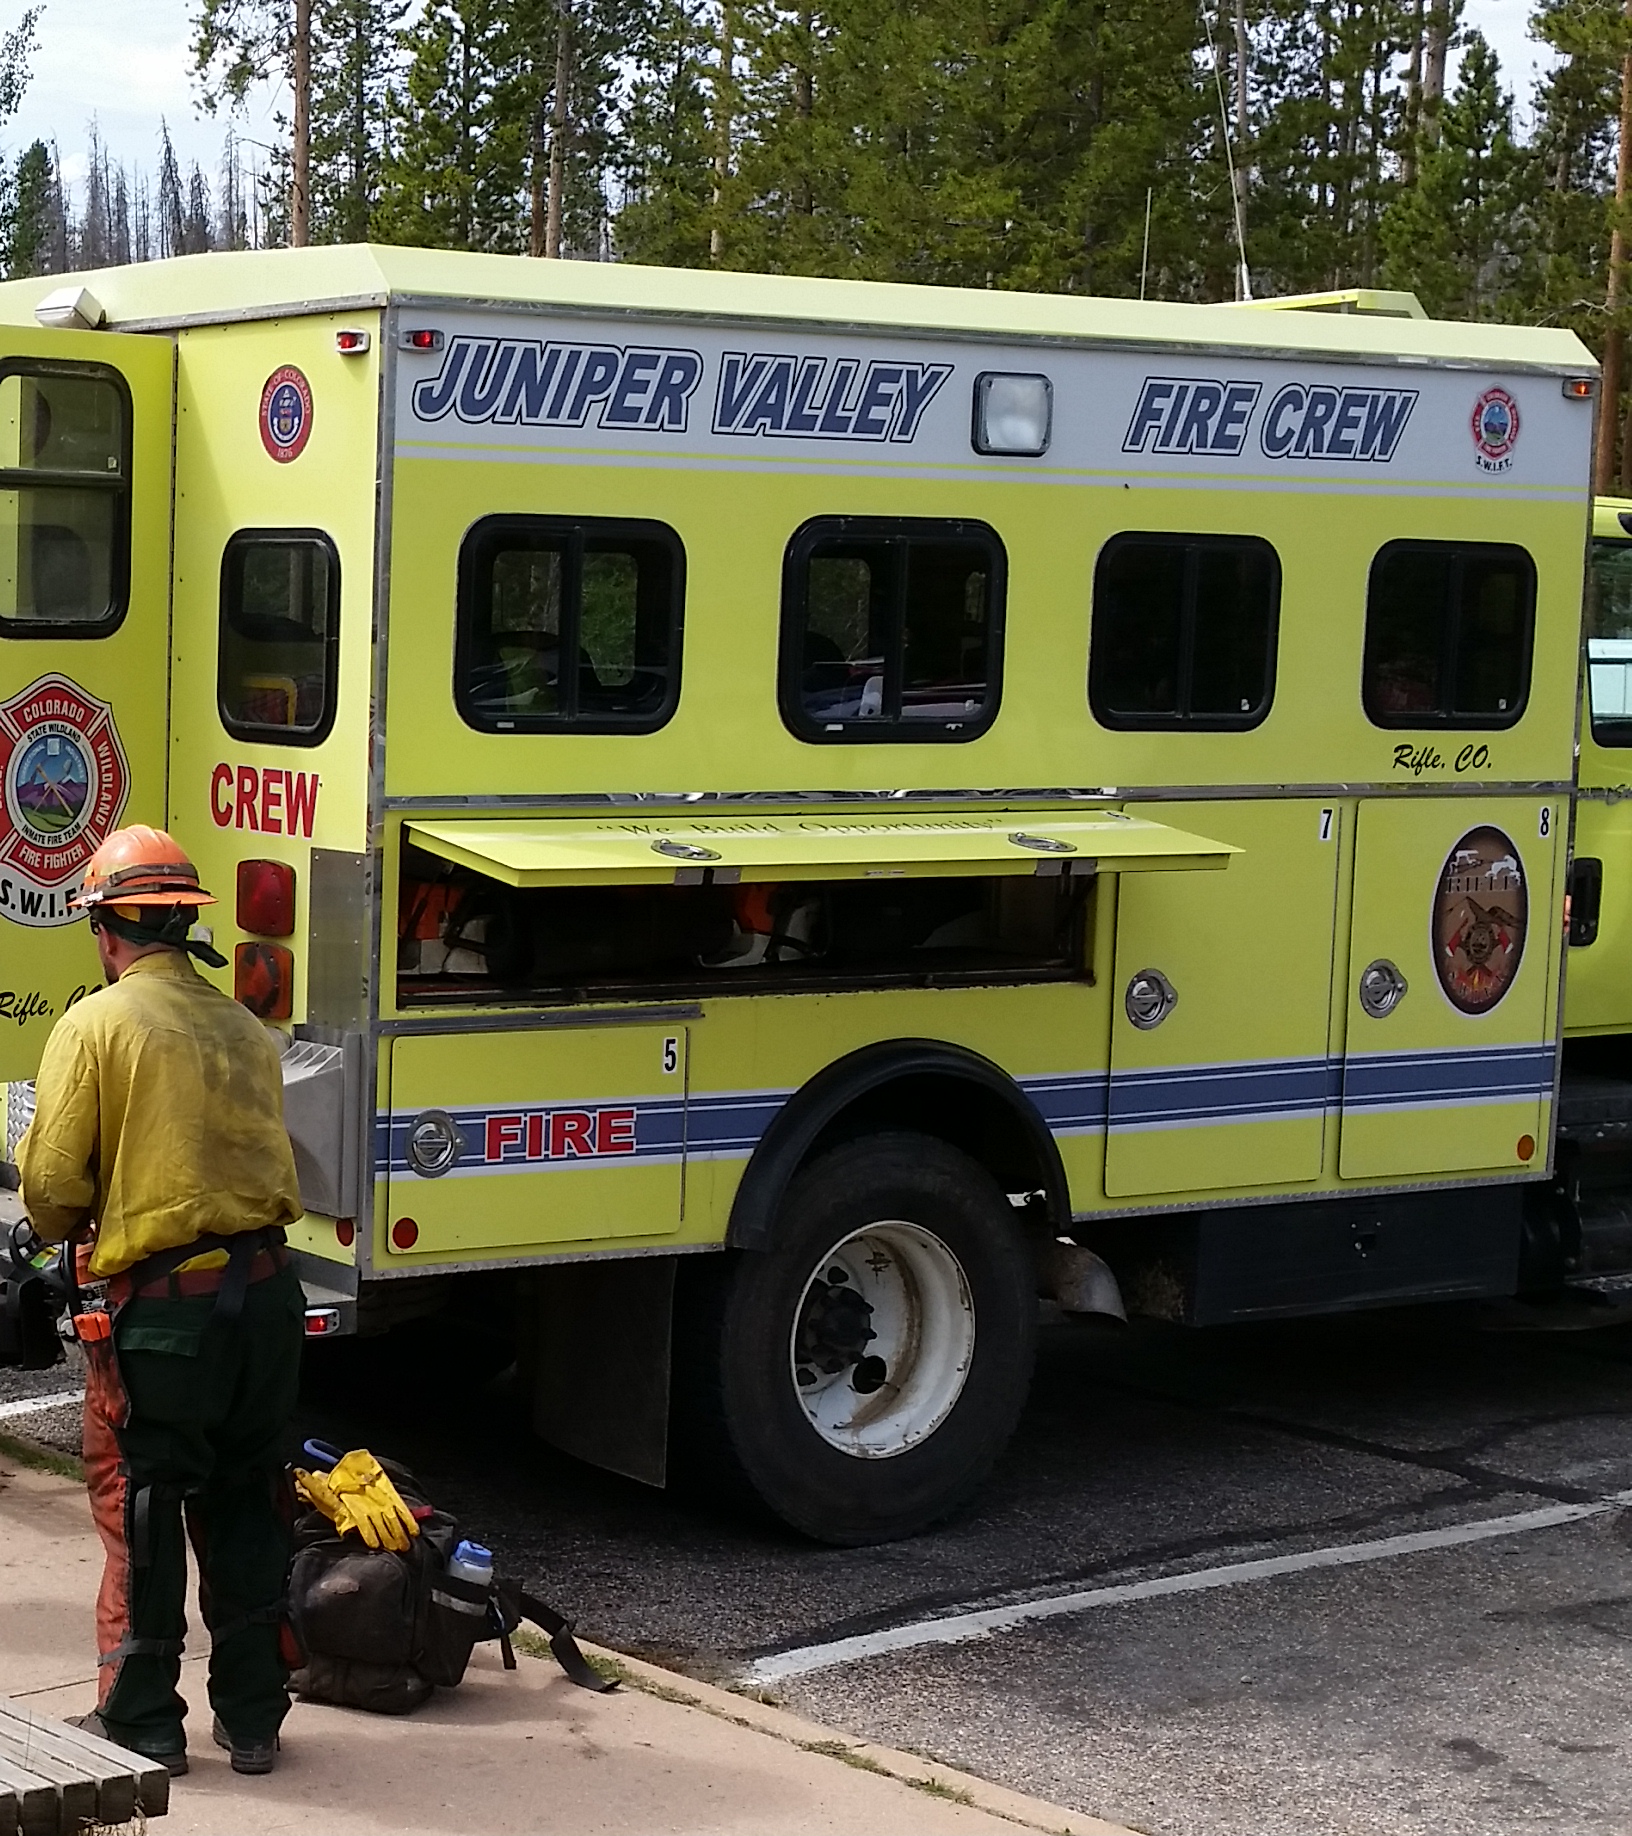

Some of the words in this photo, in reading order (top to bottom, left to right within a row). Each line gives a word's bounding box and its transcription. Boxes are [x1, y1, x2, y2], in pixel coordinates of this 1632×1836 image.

[261, 385, 274, 416] STATE
[411, 335, 703, 433] JUNIPER
[711, 350, 955, 442] VALLEY
[1121, 376, 1263, 455] FIRE
[1259, 382, 1420, 462] CREW
[23, 699, 85, 723] COLORADO
[27, 724, 48, 743] STATE
[49, 723, 81, 743] WILDLAND
[1454, 743, 1493, 773] CO.
[97, 741, 114, 826] WILDLAND
[210, 762, 320, 839] CREW
[22, 824, 46, 844] INMATE
[47, 833, 63, 845] FIRE
[63, 822, 82, 842] TEAM
[689, 823, 786, 834] Build
[1321, 809, 1333, 839] 7
[1539, 807, 1550, 836] 8
[19, 845, 41, 868] FIRE
[44, 843, 86, 869] FIGHTER
[663, 1038, 677, 1072] 5
[484, 1106, 637, 1163] FIRE
